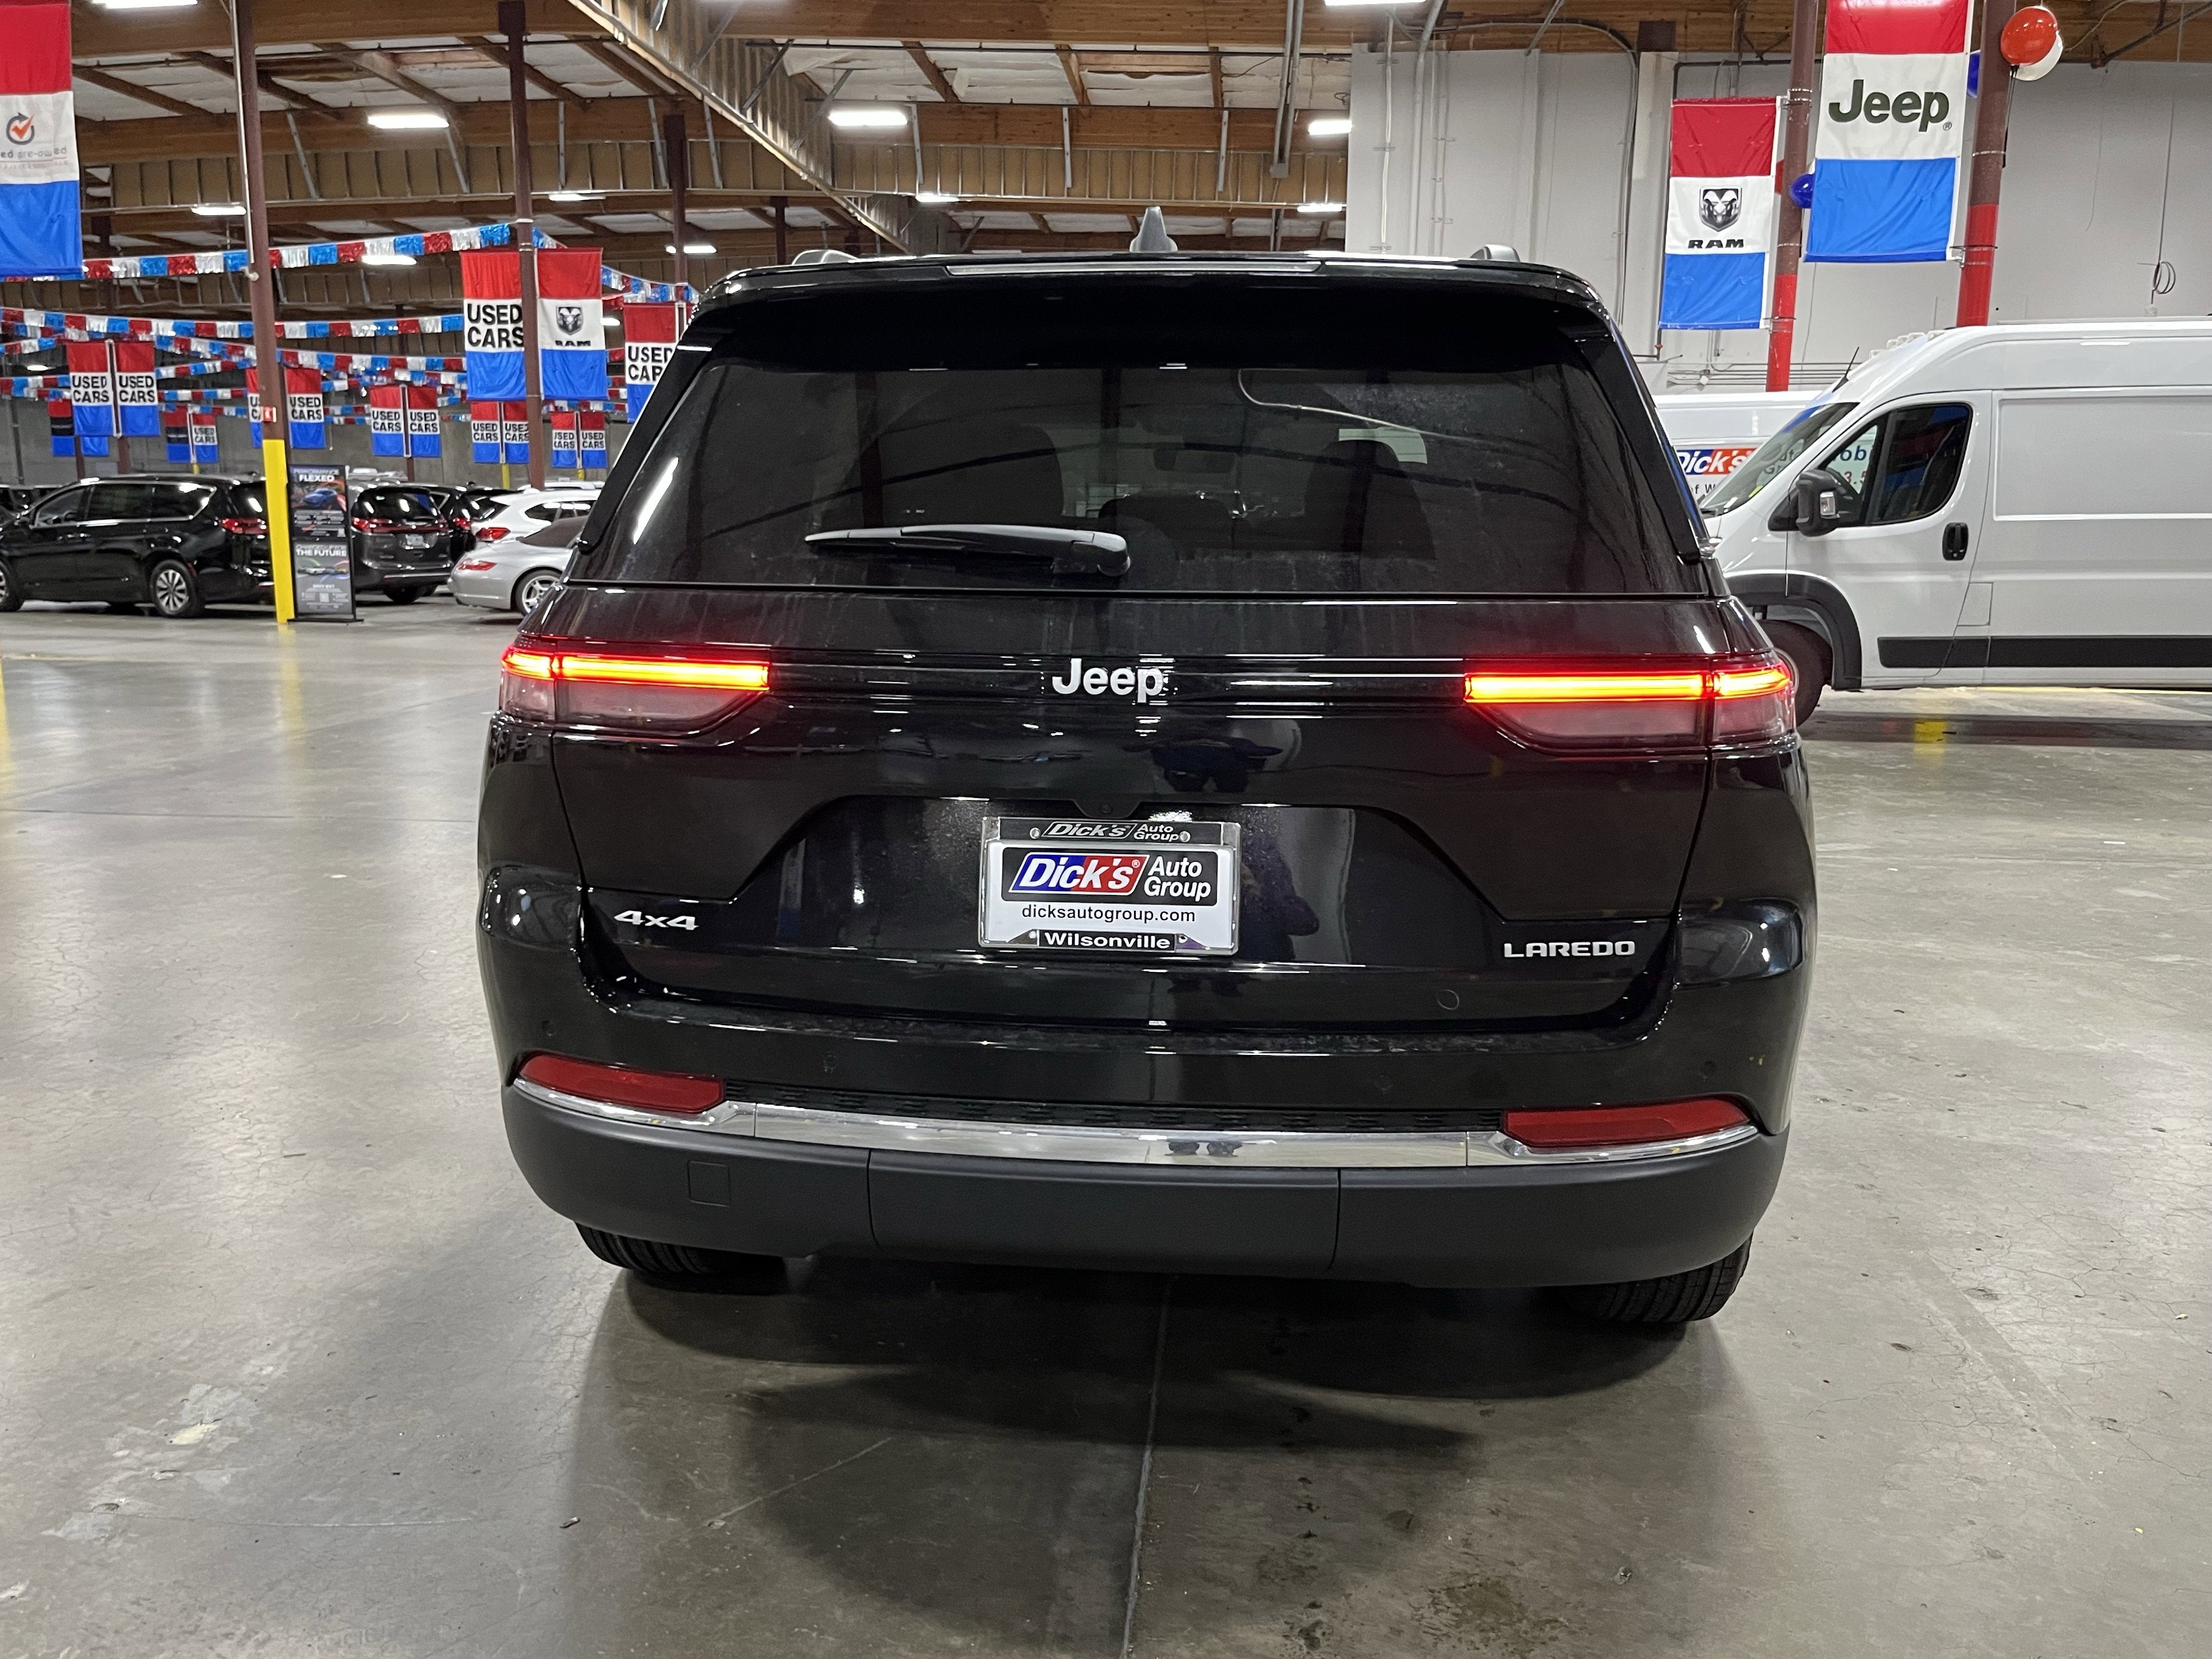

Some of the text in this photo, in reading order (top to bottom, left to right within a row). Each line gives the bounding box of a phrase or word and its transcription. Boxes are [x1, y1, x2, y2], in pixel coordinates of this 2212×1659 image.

[1829, 79, 1949, 132] Jeep
[1688, 239, 1744, 249] RAM
[467, 303, 523, 325] USED
[467, 326, 523, 348] CARS
[628, 364, 663, 381] CAR
[72, 375, 107, 388] USED
[119, 375, 154, 388] USED
[73, 390, 109, 403] CARS
[119, 390, 155, 403] CARS
[290, 397, 321, 407] USED
[291, 409, 322, 420] CARS
[373, 410, 400, 421] USED
[410, 411, 437, 421] USED
[373, 421, 402, 432] CARS
[410, 422, 438, 432] CARS
[473, 422, 498, 432] USED
[473, 432, 498, 442] CARS
[582, 432, 603, 440] USED
[582, 441, 604, 449] CARS
[1052, 658, 1164, 703] Jeep
[1047, 823, 1127, 837] Dick's
[1137, 823, 1174, 833] Auto
[1133, 831, 1180, 842] Group
[1147, 856, 1203, 877] Auto
[1019, 857, 1134, 890] Dick's
[1143, 877, 1211, 902] Group
[614, 910, 699, 930] 4x4
[1022, 904, 1195, 924] dicksautogroup.com
[1044, 932, 1171, 950] Wilsonville
[1504, 941, 1635, 957] LAREDO
